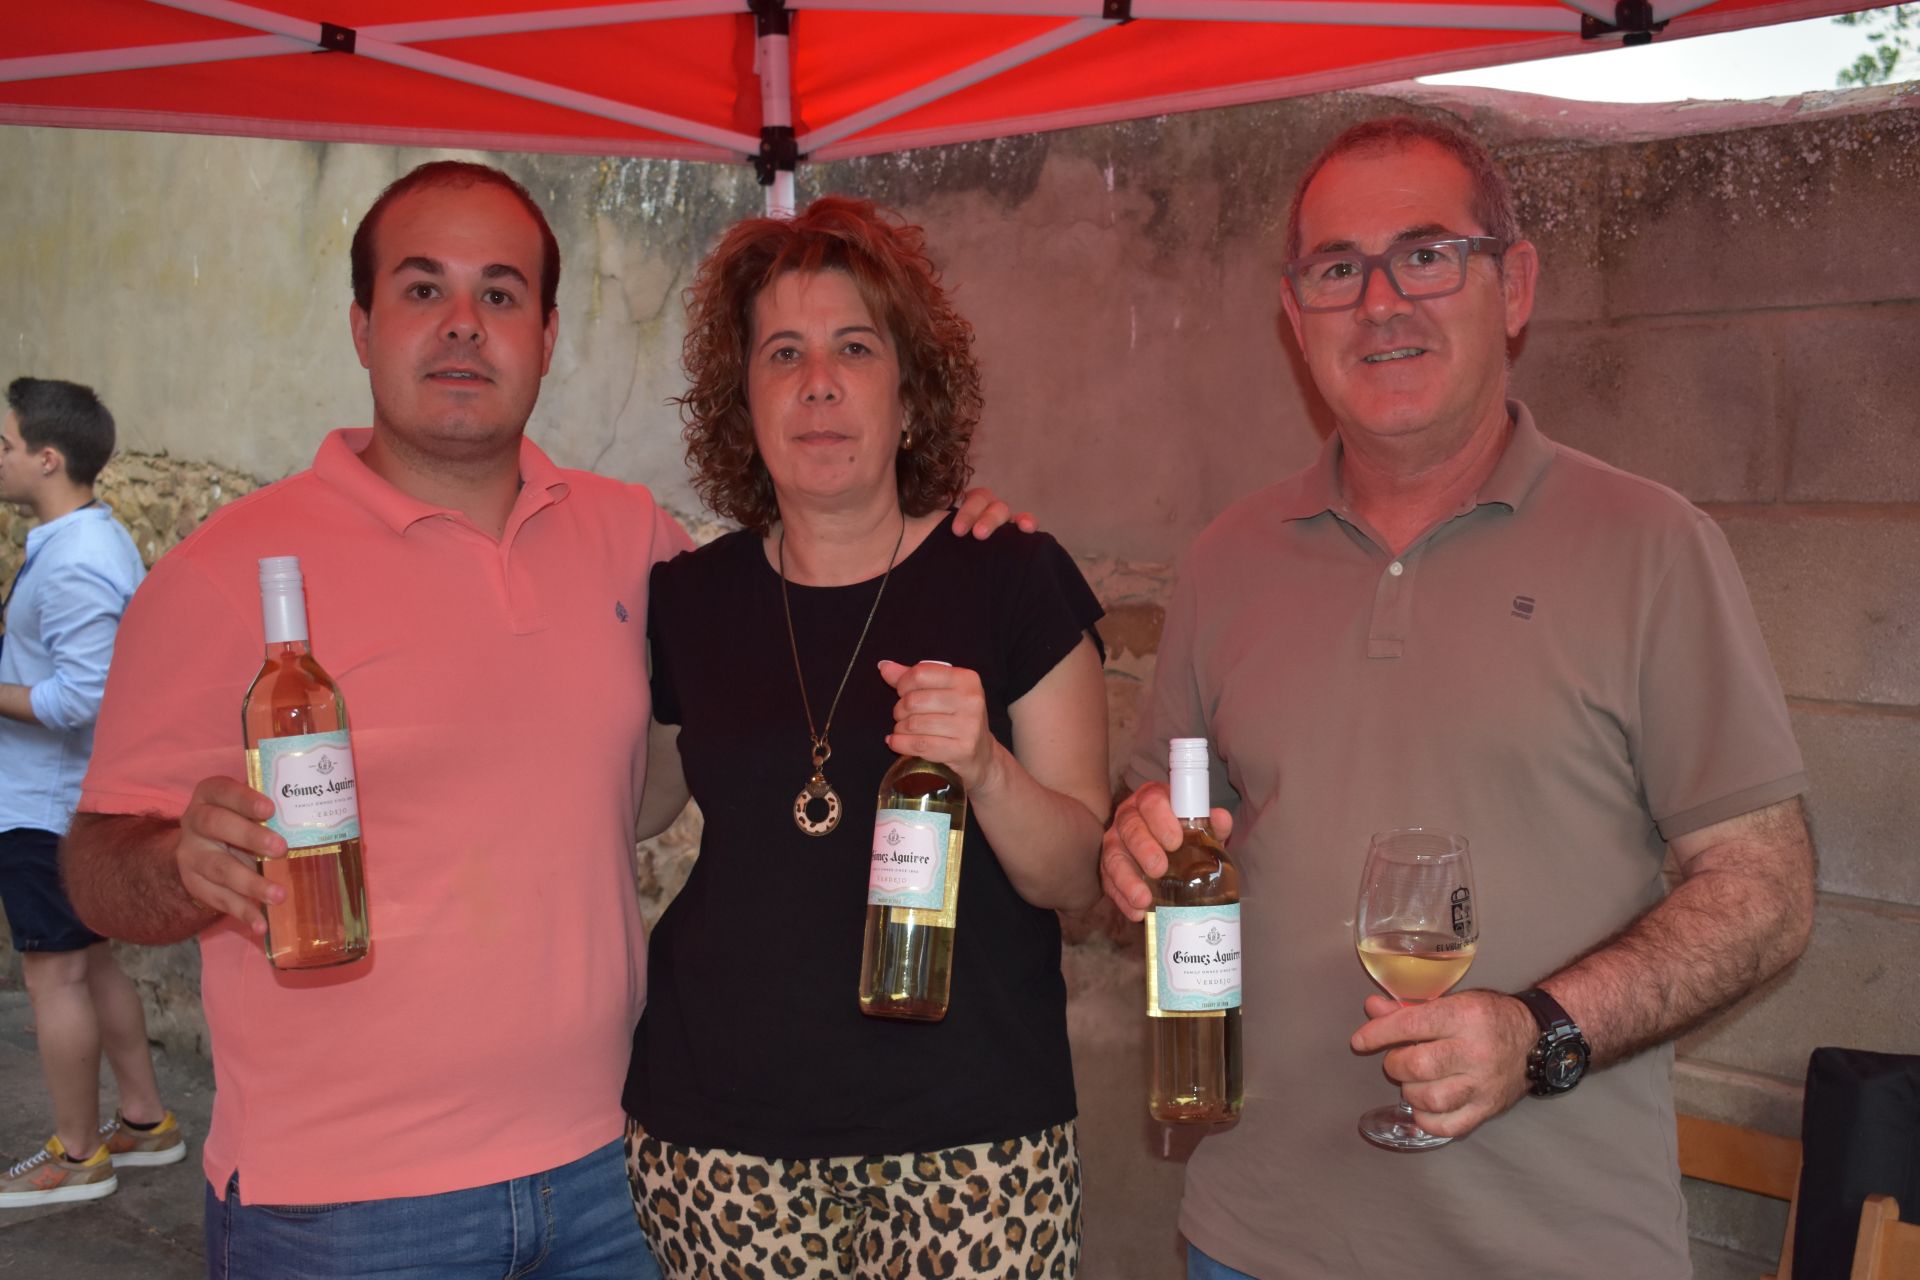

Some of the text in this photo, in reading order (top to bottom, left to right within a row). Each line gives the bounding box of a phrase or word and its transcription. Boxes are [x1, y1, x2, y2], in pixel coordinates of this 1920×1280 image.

[281, 777, 355, 798] Gómez Aguirr
[889, 849, 930, 865] Aguirre
[1172, 950, 1211, 966] Gómez
